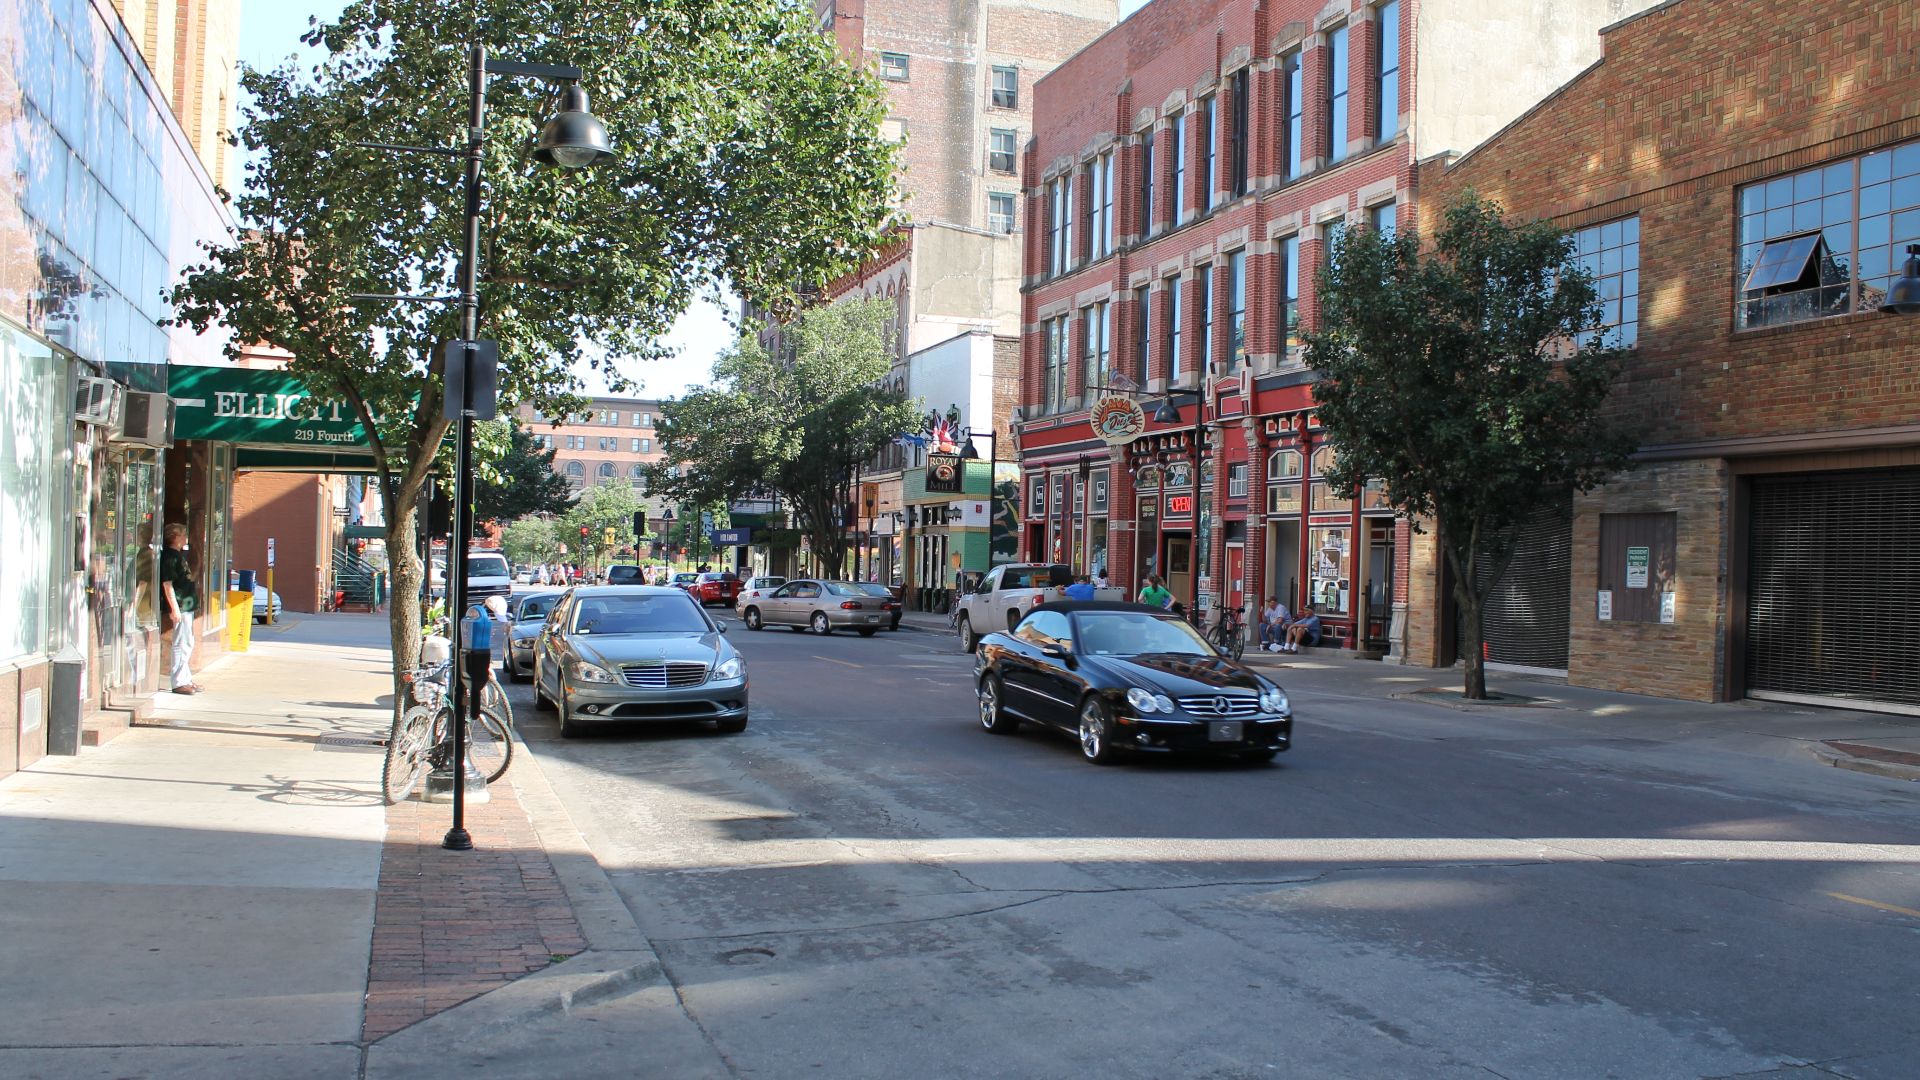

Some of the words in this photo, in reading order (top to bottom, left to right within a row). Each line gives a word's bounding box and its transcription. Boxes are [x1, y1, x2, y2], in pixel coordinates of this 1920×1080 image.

[294, 429, 315, 441] 219
[317, 430, 355, 442] Fourth
[1171, 496, 1191, 512] OPEN
